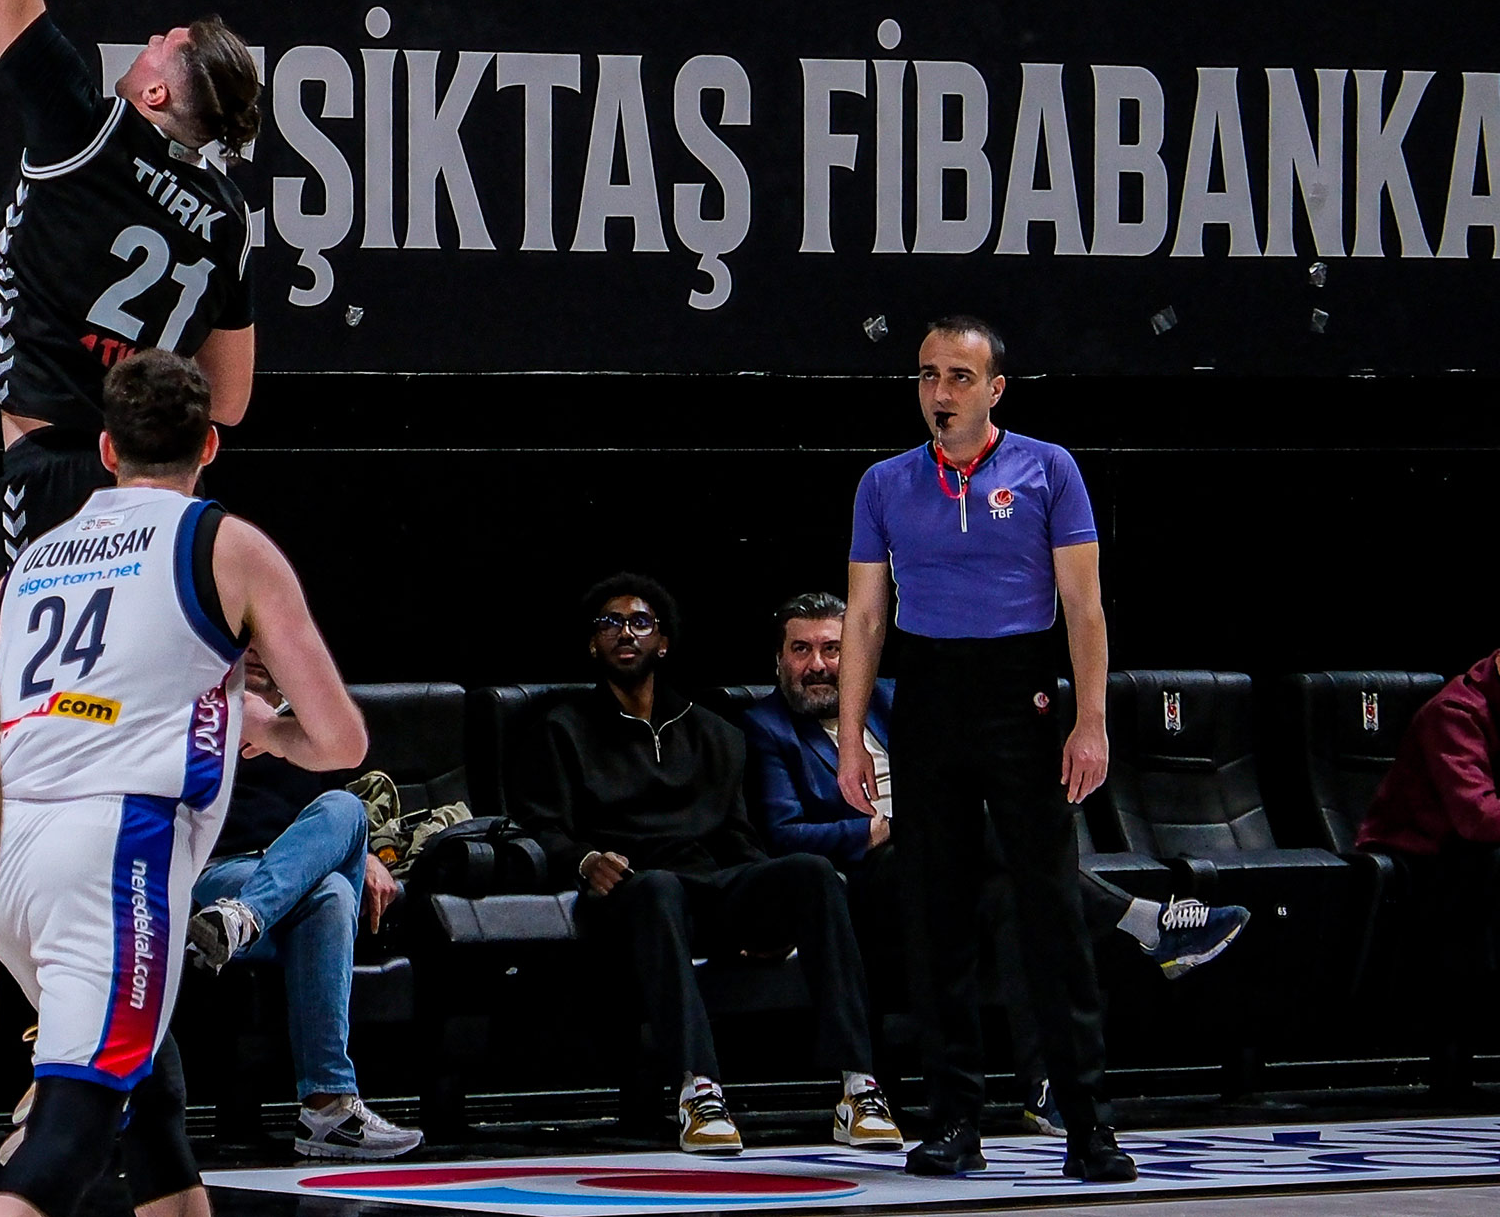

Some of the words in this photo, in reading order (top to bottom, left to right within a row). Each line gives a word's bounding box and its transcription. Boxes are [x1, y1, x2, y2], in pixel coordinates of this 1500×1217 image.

[98, 6, 752, 311] ŞİKTAŞ
[799, 18, 1500, 259] FİBABANKA
[133, 157, 226, 243] TÜRK
[86, 224, 217, 353] 21
[22, 527, 156, 574] UZUNHASAN
[989, 508, 1014, 520] TBF
[17, 561, 143, 597] sigortam.net
[19, 586, 115, 701] 24
[57, 696, 115, 721] com
[129, 858, 148, 1011] neredekal.com
